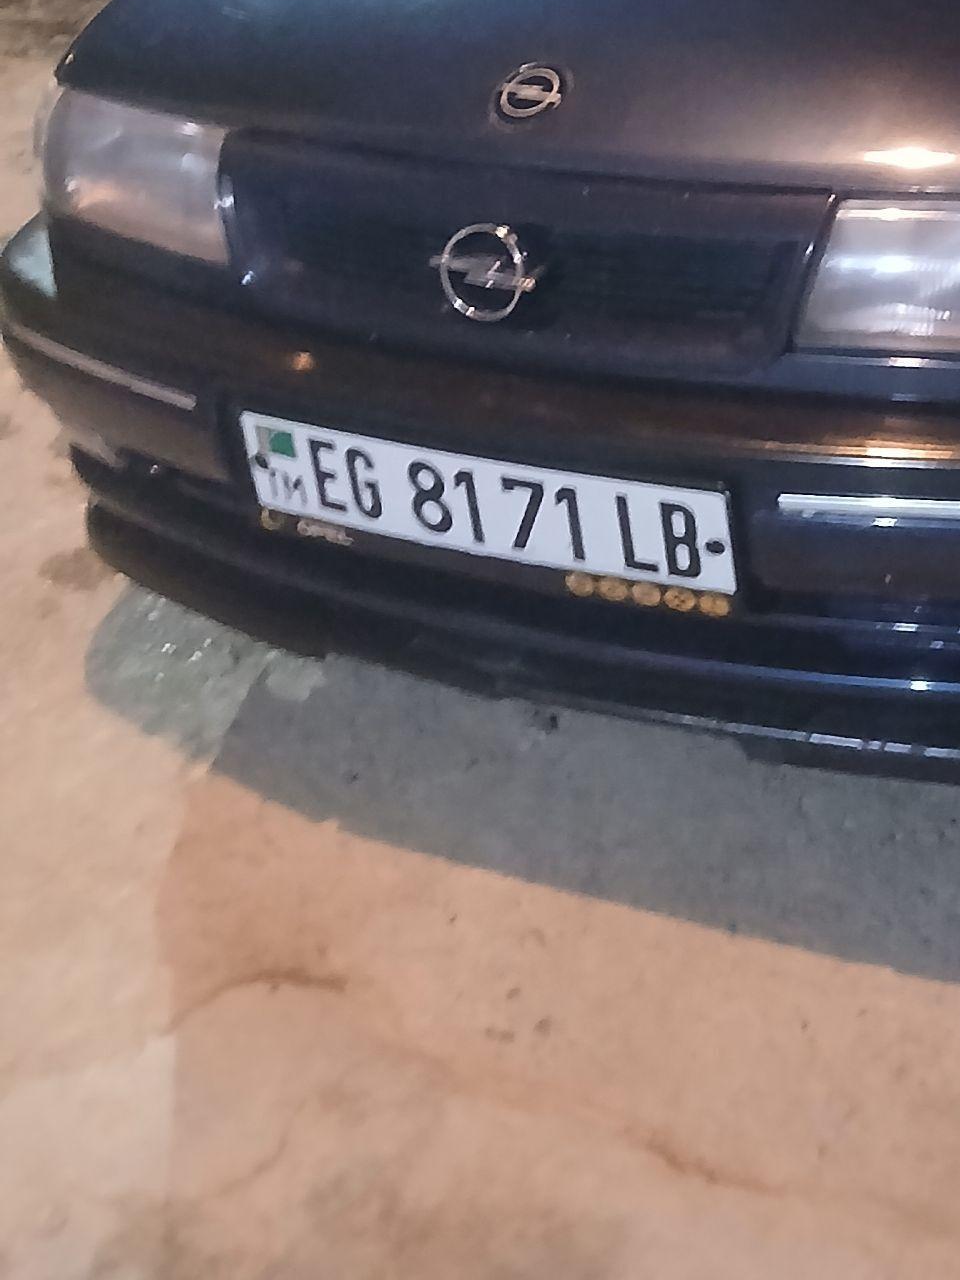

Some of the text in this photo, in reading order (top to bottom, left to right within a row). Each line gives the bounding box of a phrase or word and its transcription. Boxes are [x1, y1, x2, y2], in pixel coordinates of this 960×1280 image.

[309, 440, 702, 578] EG 8171 LB
